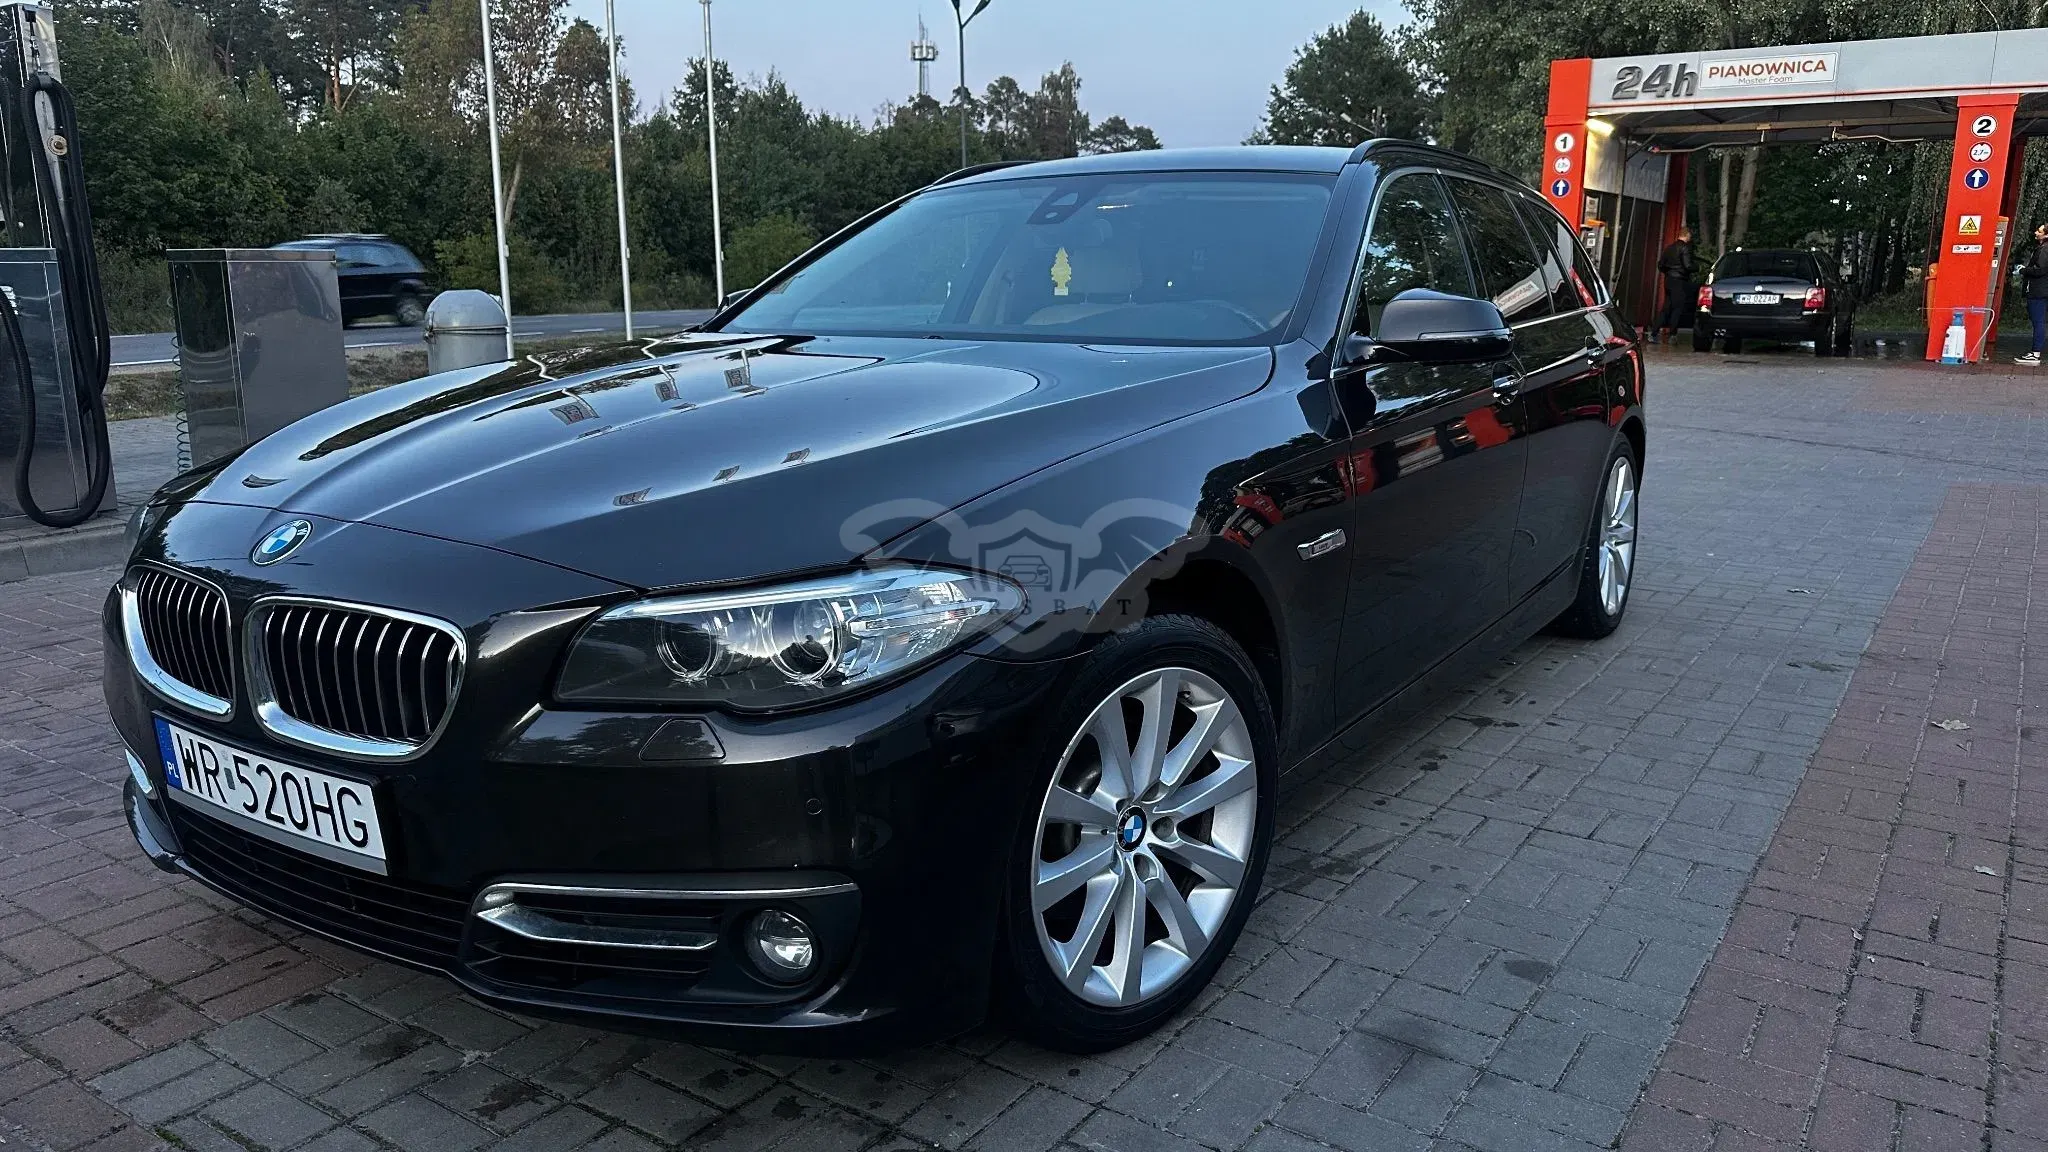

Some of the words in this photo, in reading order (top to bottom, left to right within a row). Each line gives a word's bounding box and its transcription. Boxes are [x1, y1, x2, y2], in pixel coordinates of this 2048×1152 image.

[1708, 59, 1828, 79] PIANOWNICA
[1611, 63, 1698, 100] 24h
[1738, 77, 1767, 85] Master
[1768, 75, 1793, 83] Foam
[1977, 118, 1992, 134] 2
[1560, 136, 1568, 149] 1
[166, 760, 180, 779] PL
[176, 732, 228, 805] WR
[232, 754, 369, 849] 520HG
